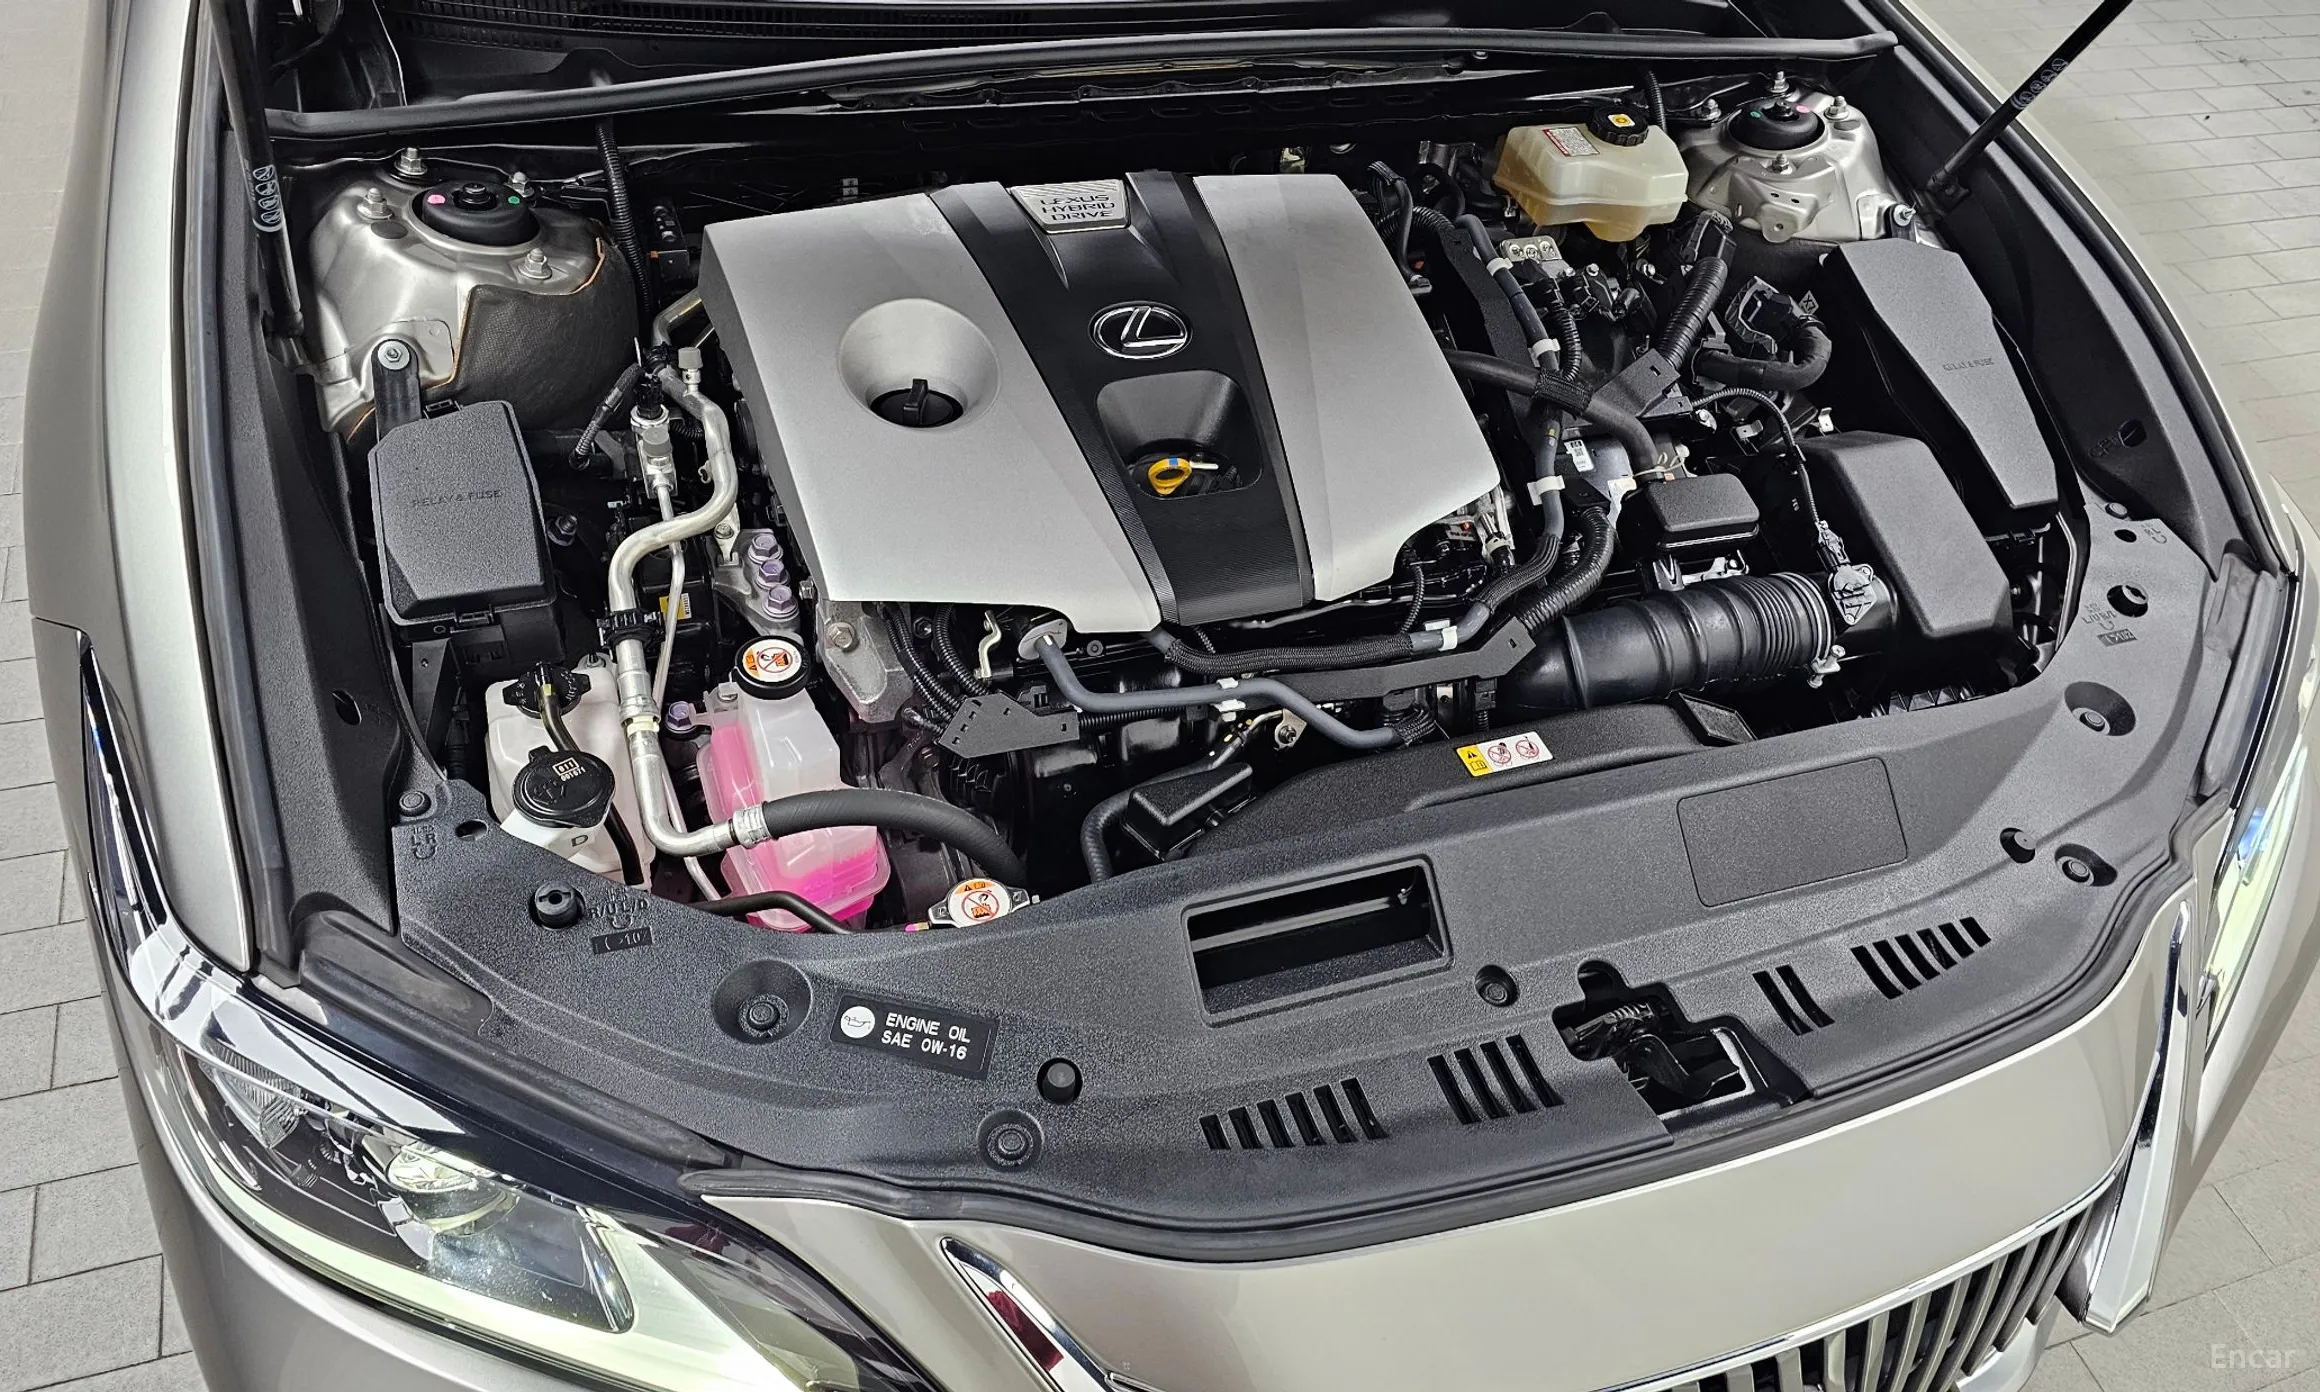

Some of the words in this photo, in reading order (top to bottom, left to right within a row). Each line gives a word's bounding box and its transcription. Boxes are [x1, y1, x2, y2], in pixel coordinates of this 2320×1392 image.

[1041, 194, 1110, 205] LEXUS
[1042, 202, 1116, 213] HYBRID
[1051, 211, 1113, 221] DRIVE
[885, 1012, 941, 1036] ENGINE
[948, 1025, 971, 1044] OIL
[881, 1030, 914, 1049] SAE
[921, 1038, 968, 1061] 0W-16
